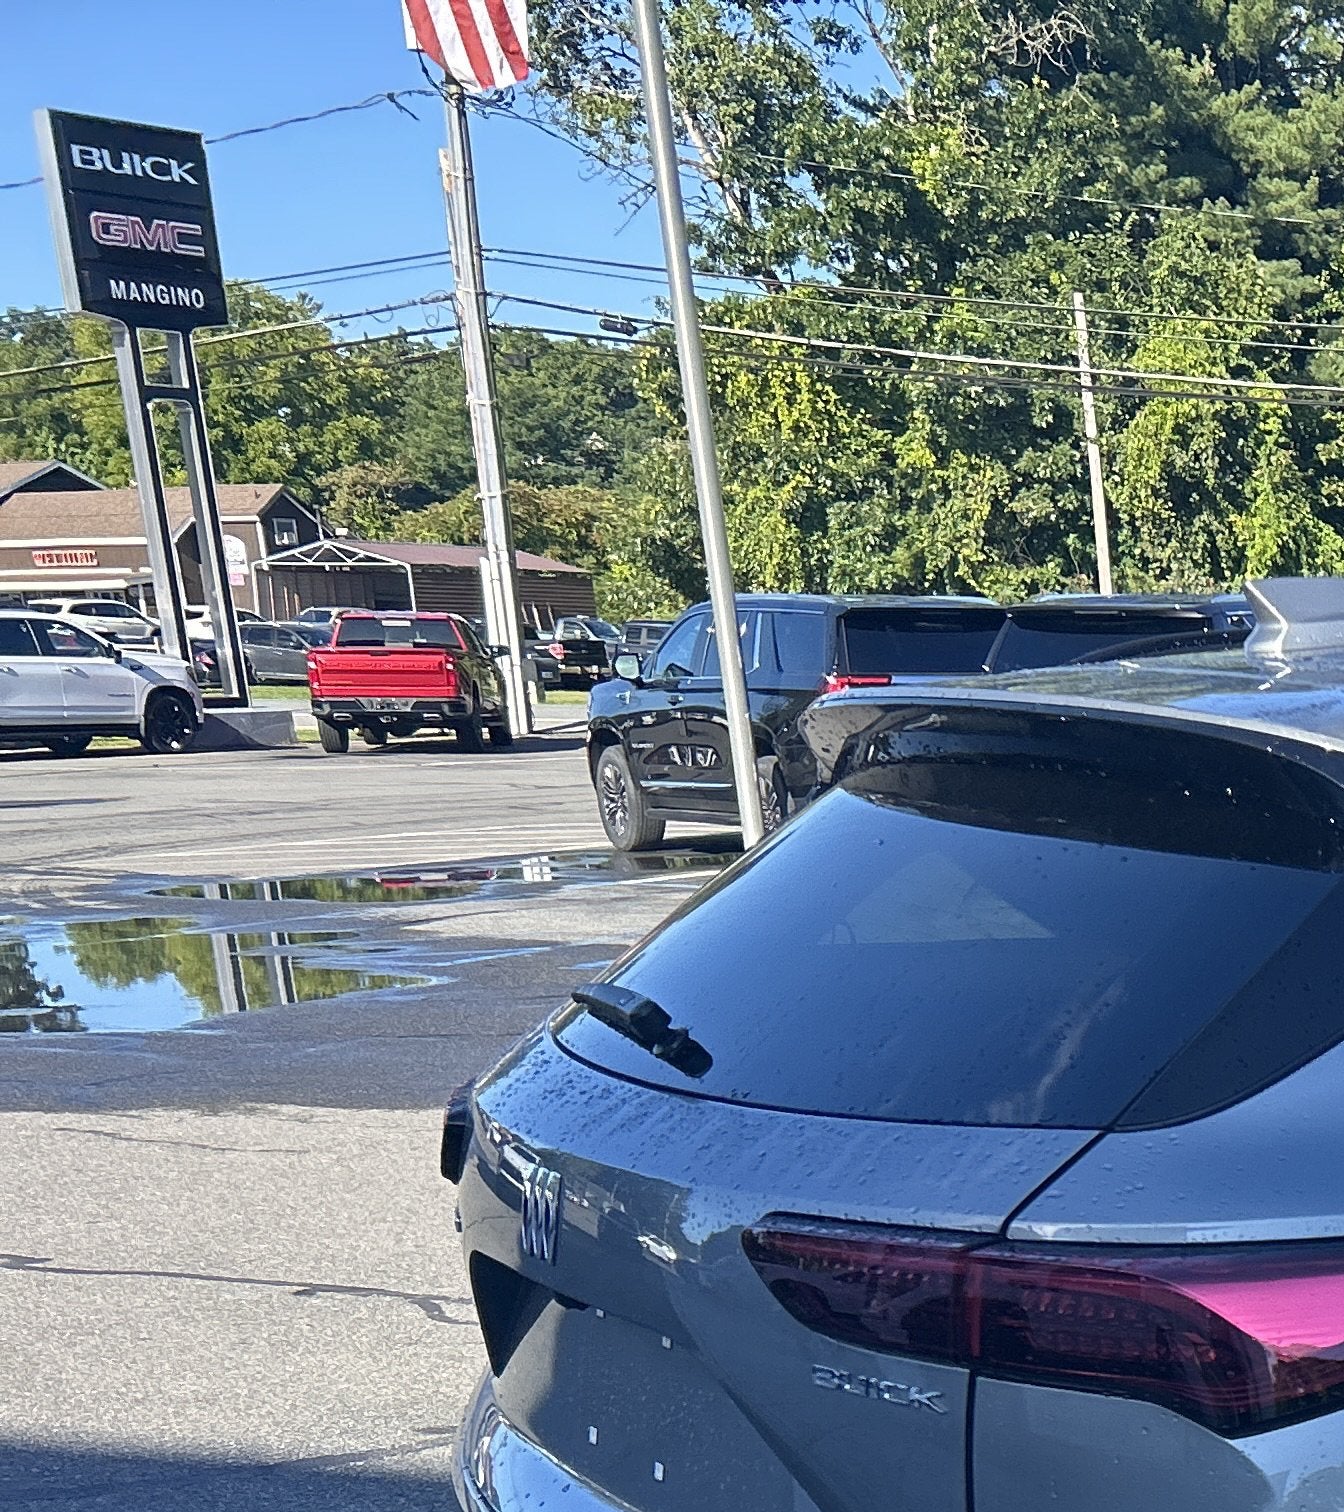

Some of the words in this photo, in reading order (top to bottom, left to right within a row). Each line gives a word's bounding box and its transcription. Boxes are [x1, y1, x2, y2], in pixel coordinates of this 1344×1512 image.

[70, 143, 198, 185] BUICK
[89, 210, 205, 257] GMC
[109, 279, 205, 309] MANGINO
[812, 1363, 947, 1415] BUICK
